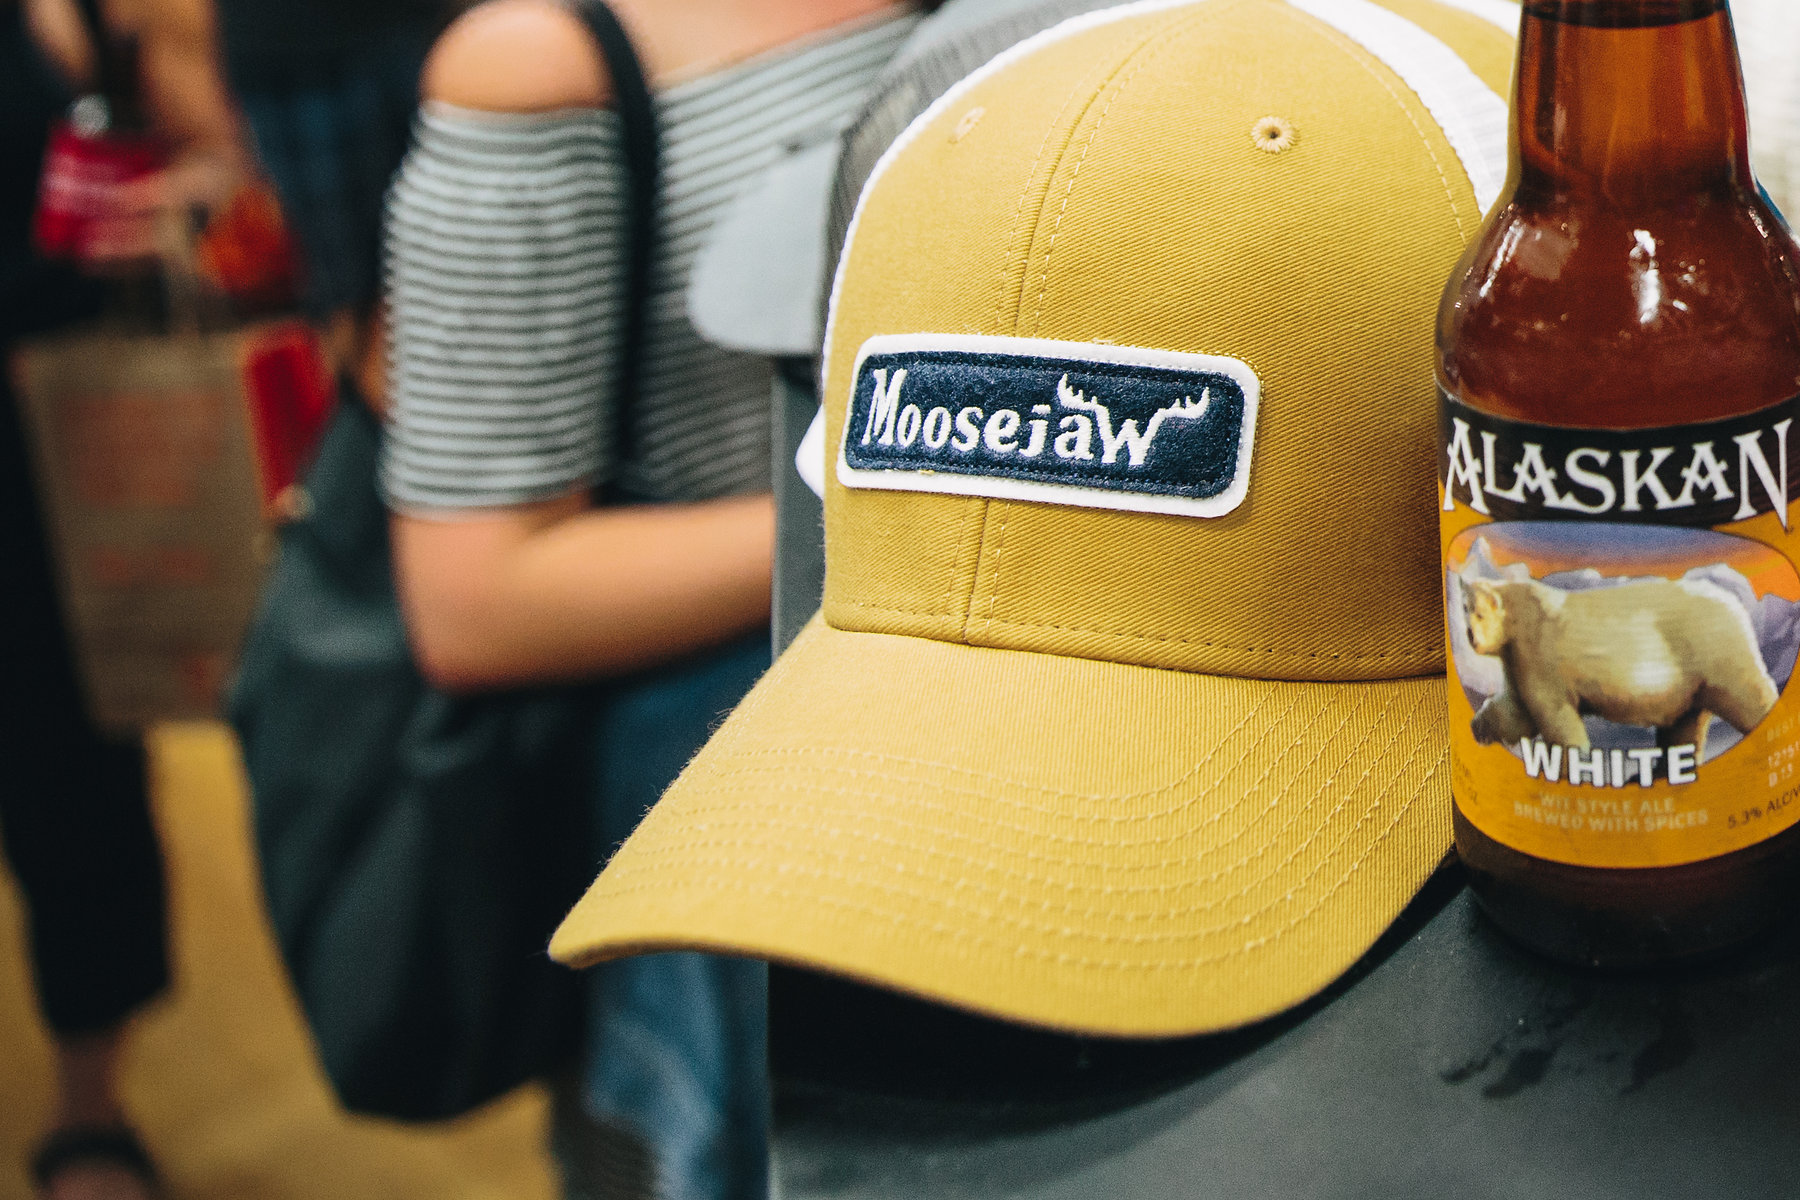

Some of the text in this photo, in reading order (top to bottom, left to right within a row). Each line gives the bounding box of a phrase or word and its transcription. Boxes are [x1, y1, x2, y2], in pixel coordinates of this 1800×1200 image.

[861, 368, 1211, 467] Moosejaw
[1443, 416, 1793, 531] ALASKAN
[1520, 736, 1697, 789] WHITE
[1513, 800, 1709, 833] BREWED WITH SPICES
[1577, 797, 1632, 815] STYLE
[1639, 798, 1675, 815] ALE
